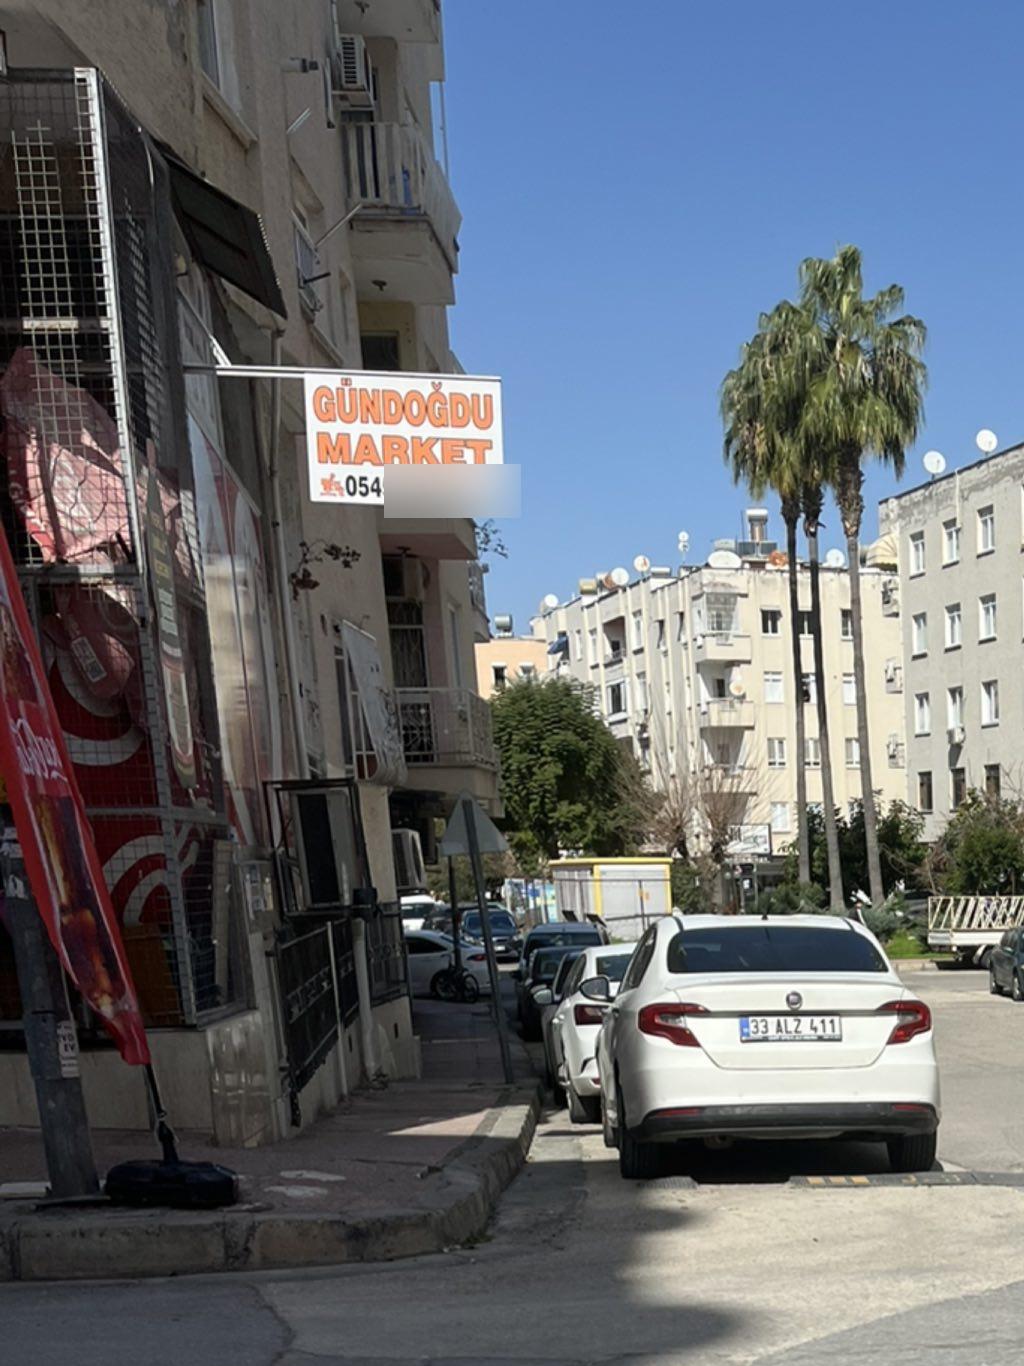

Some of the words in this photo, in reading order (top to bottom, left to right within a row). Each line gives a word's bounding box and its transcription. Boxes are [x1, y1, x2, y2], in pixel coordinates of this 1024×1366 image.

[312, 377, 494, 430] GÜNDOĞDU
[316, 432, 493, 465] MARKET
[345, 475, 384, 497] 054
[751, 1018, 769, 1035] 33
[775, 1018, 802, 1035] ALZ
[810, 1018, 836, 1034] 411
